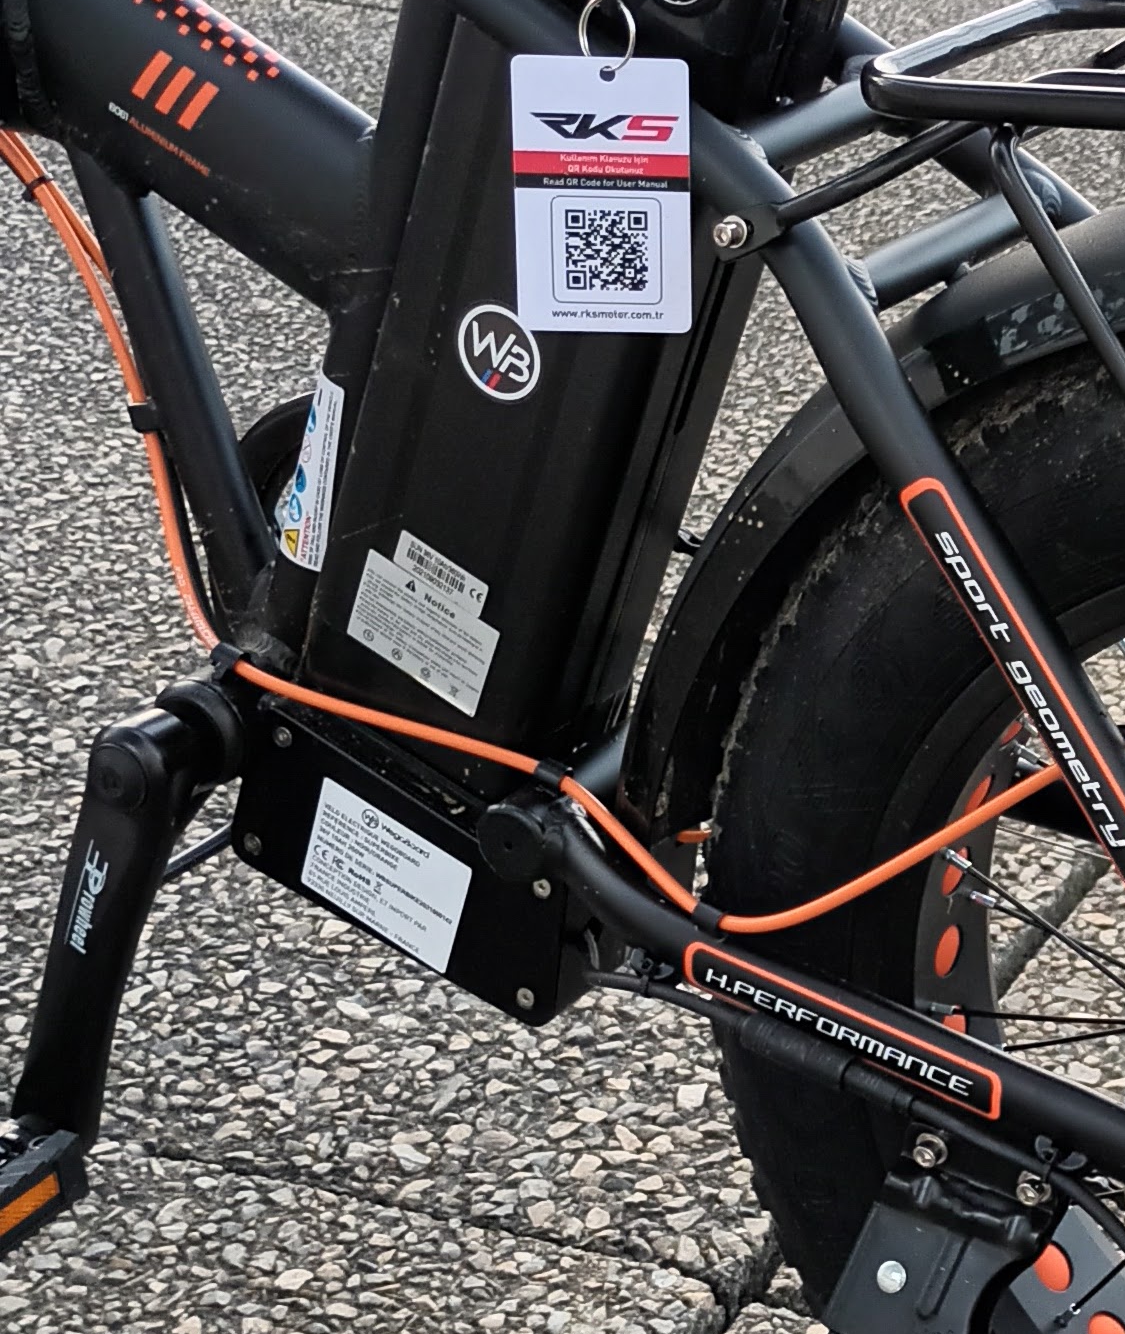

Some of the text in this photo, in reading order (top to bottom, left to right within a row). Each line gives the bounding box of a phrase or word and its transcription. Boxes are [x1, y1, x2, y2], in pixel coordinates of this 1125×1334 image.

[530, 112, 680, 142] RKS
[567, 164, 580, 173] QR
[543, 177, 668, 189] Read QR Code for User Manual
[551, 309, 664, 320] www.rksmotor.com.tr
[468, 586, 483, 603] CE
[935, 531, 1011, 643] sport
[423, 592, 456, 619] Notice
[313, 842, 328, 860] CE
[705, 968, 974, 1096] H.PERFORMANCE
